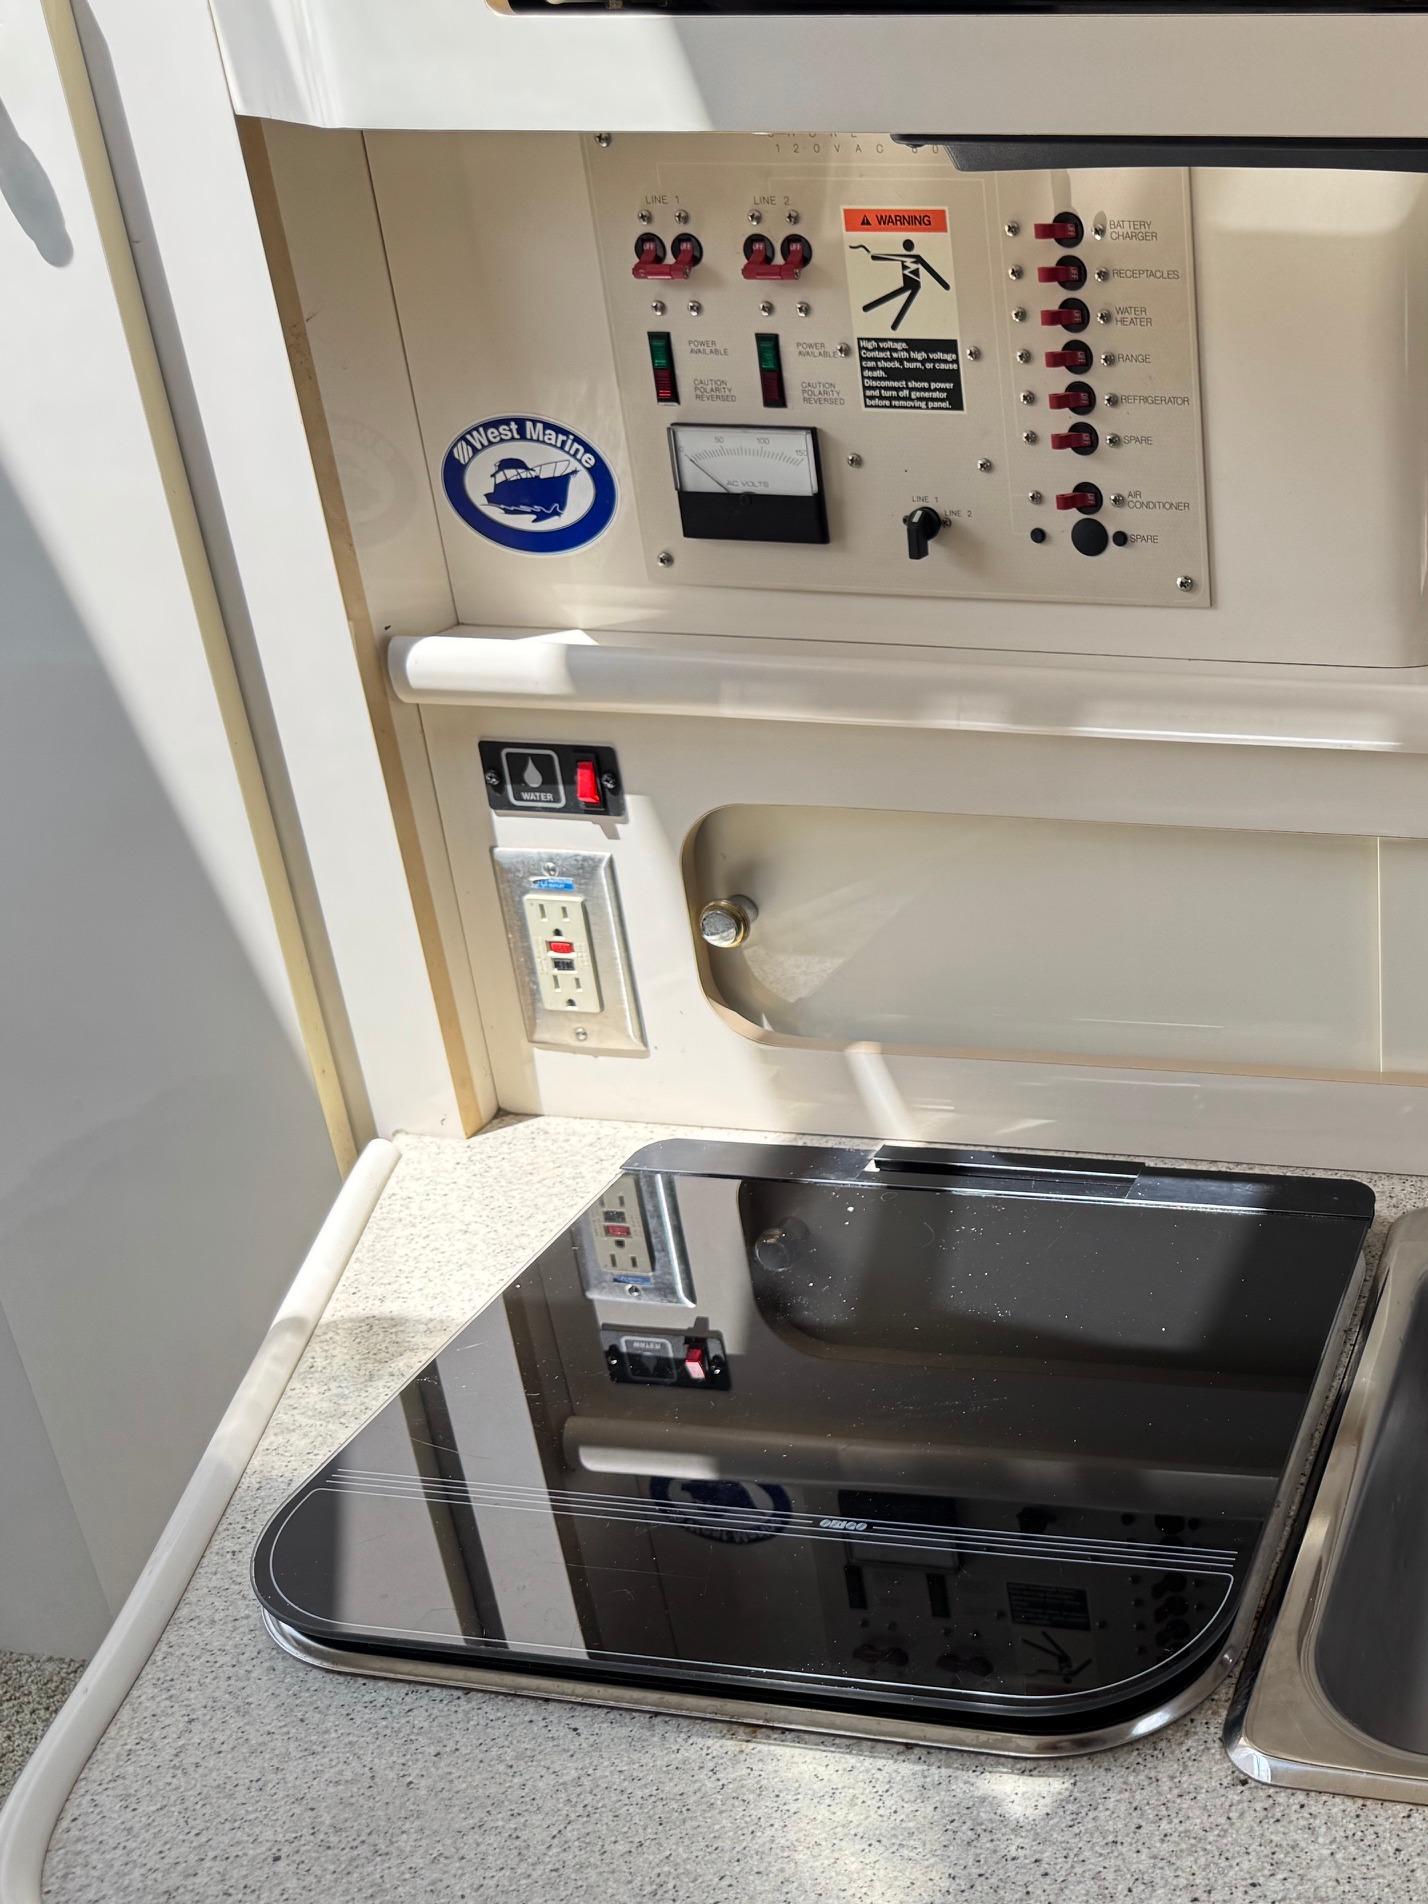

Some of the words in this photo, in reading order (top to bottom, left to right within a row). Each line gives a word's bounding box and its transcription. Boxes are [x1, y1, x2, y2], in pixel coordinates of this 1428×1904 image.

[645, 195, 668, 204] LINE
[676, 195, 680, 204] 1
[754, 196, 776, 206] LINE
[784, 196, 790, 206] 2
[876, 214, 932, 226] WARNING
[1109, 220, 1152, 230] BATTERY
[1110, 232, 1158, 241] CHARGER
[1112, 270, 1180, 280] RECEPTACLES
[1115, 306, 1146, 315] WATER
[1116, 318, 1152, 326] HEATER
[860, 340, 878, 350] High
[879, 341, 908, 350] voltage.
[861, 350, 890, 358] Contact
[910, 351, 928, 360] high
[929, 352, 956, 361] voltage
[1118, 354, 1151, 363] RANGE
[878, 360, 903, 369] shock,
[904, 361, 924, 370] burn,
[803, 397, 845, 405] REVERSED
[892, 400, 926, 408] removing
[1121, 396, 1190, 406] REFRIGERATOR
[466, 420, 520, 450] West
[525, 420, 596, 468] Marine
[1124, 437, 1152, 445] SPARE
[1128, 491, 1142, 499] AIR
[1128, 502, 1190, 510] CONDITIONER
[1130, 535, 1158, 543] SPARE
[521, 792, 553, 801] WATER
